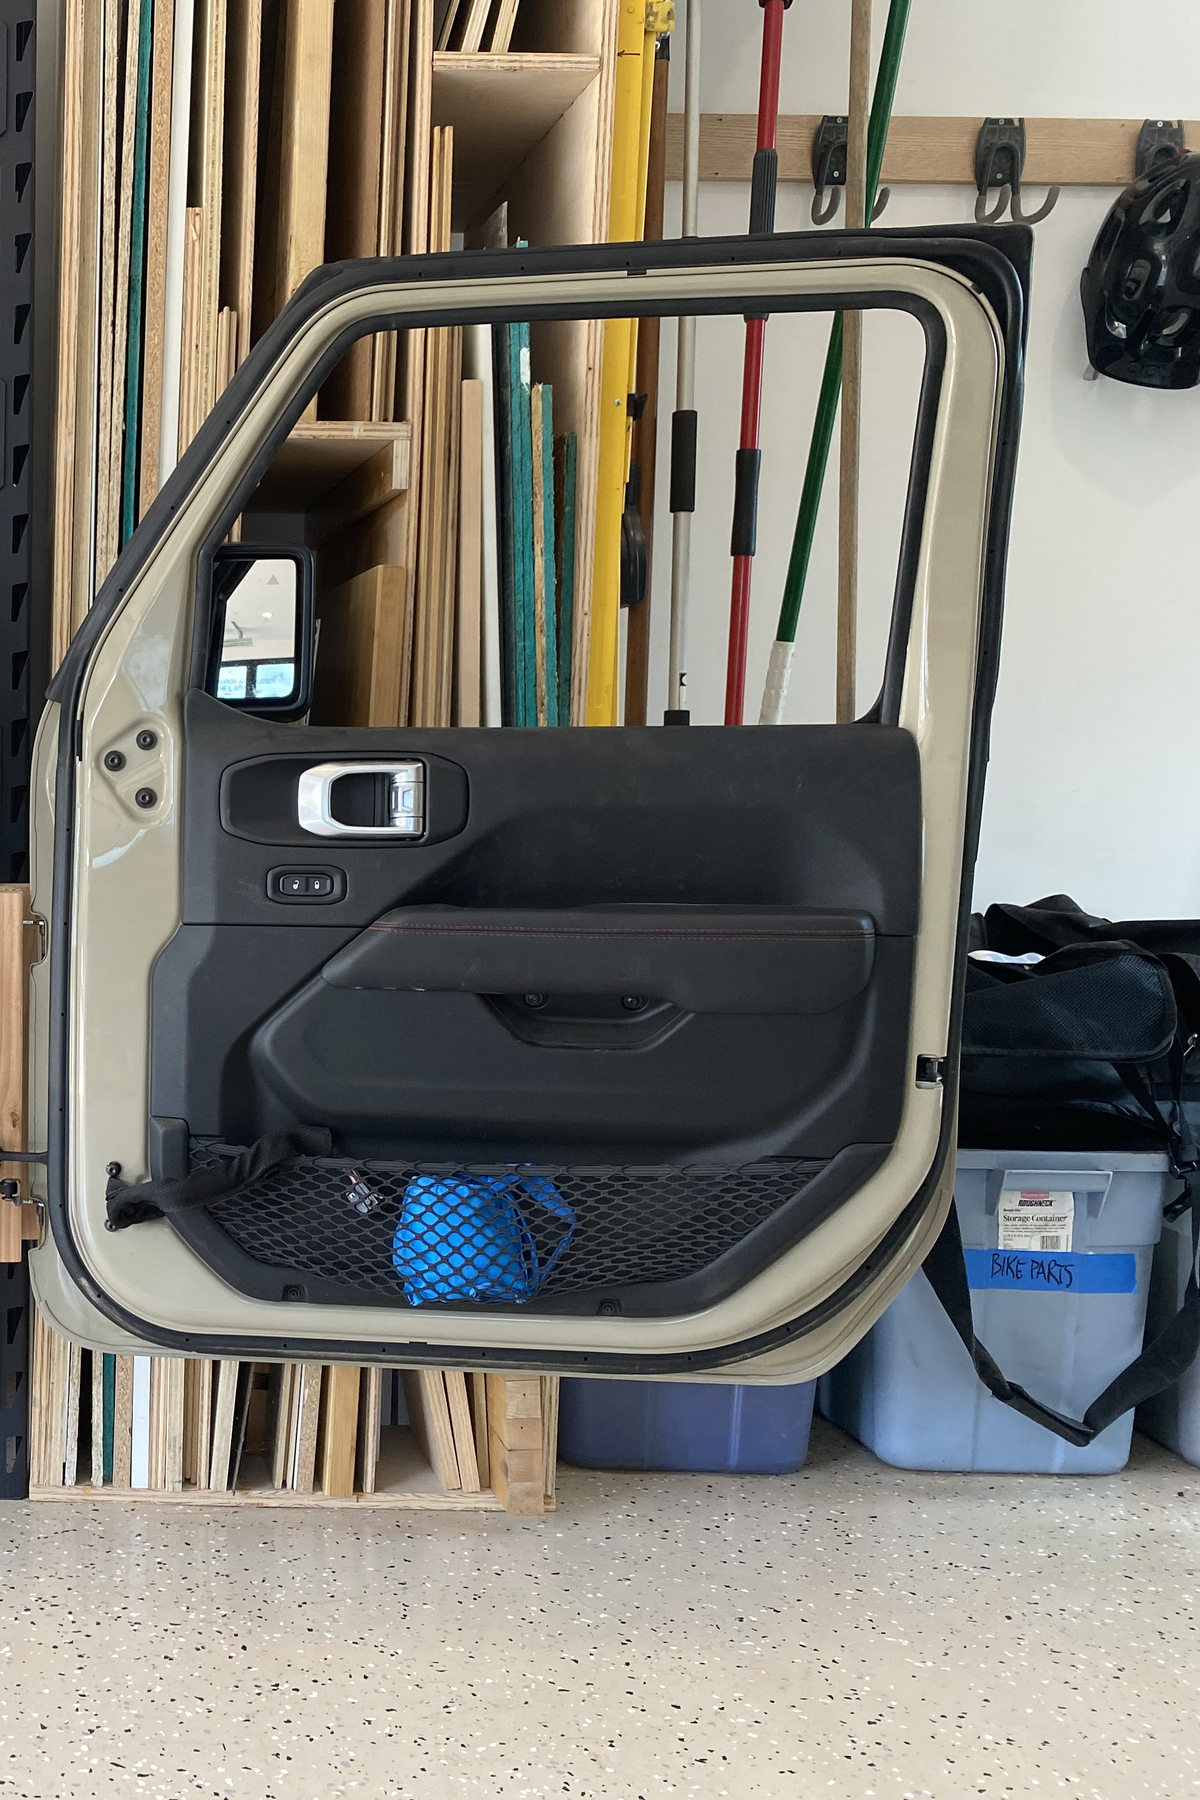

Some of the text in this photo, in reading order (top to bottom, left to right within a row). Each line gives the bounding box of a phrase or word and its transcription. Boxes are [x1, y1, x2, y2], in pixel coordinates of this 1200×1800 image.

[1003, 1214, 1068, 1223] Storage Container
[991, 1252, 1075, 1289] BIKE PARTS
